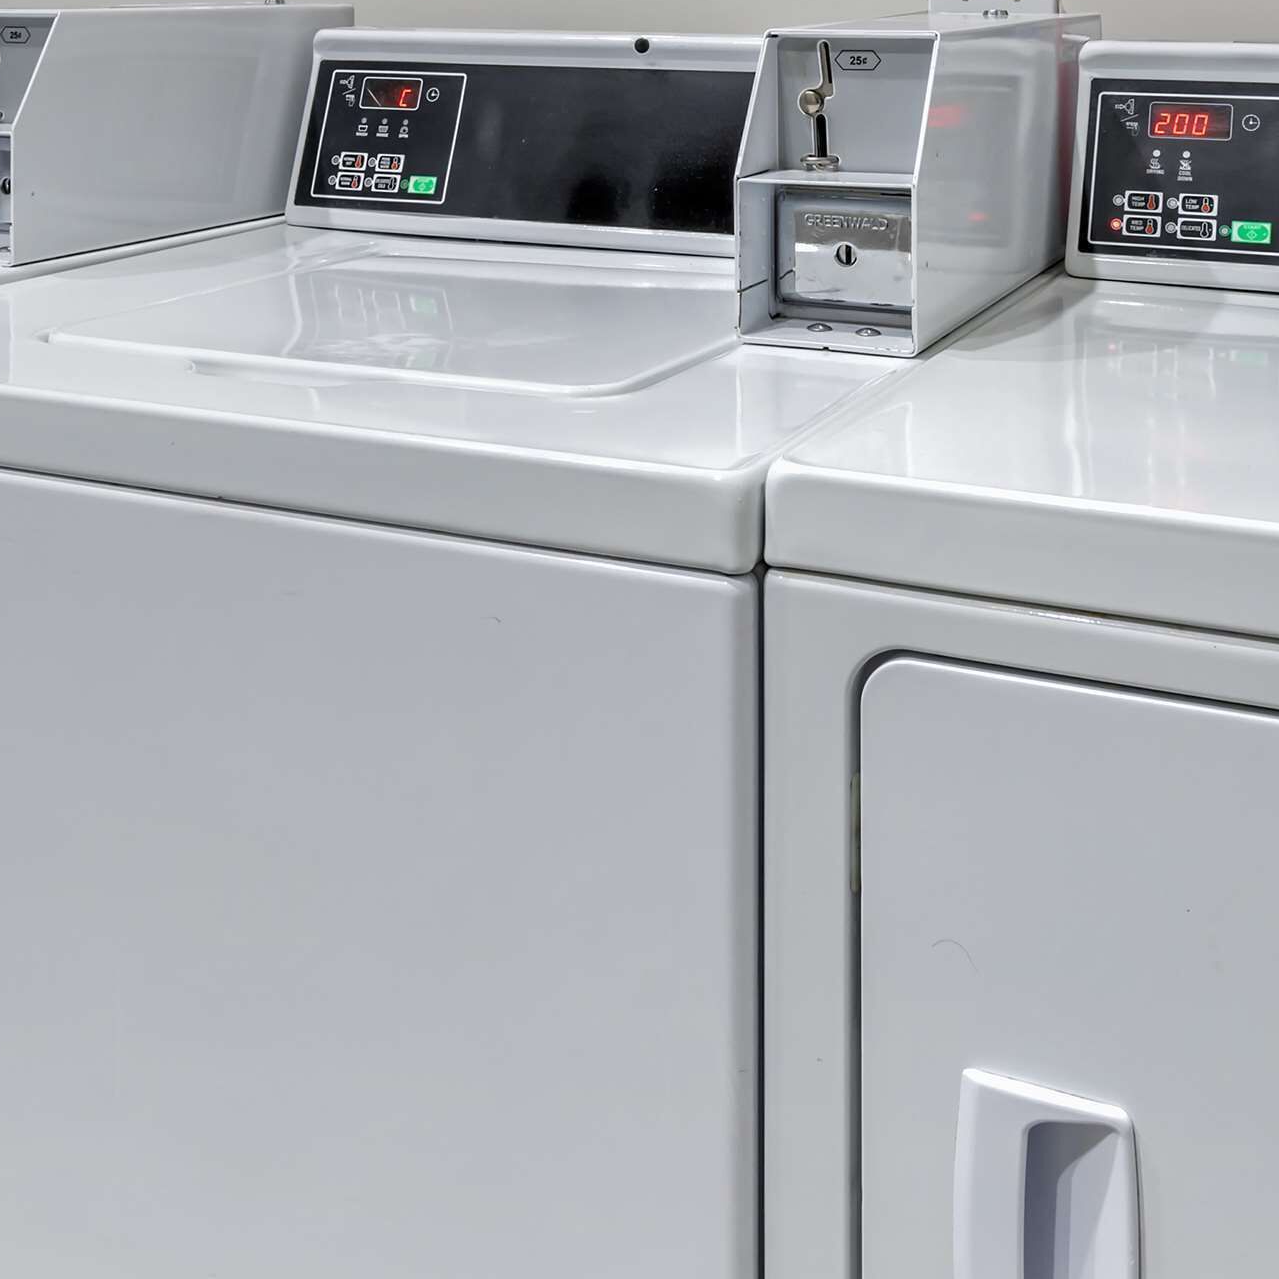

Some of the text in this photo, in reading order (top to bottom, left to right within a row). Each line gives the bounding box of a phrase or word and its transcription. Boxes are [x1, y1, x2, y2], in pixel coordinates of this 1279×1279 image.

[849, 55, 868, 66] 25¢
[1154, 113, 1209, 136] 200
[804, 212, 889, 231] GREENWALD
